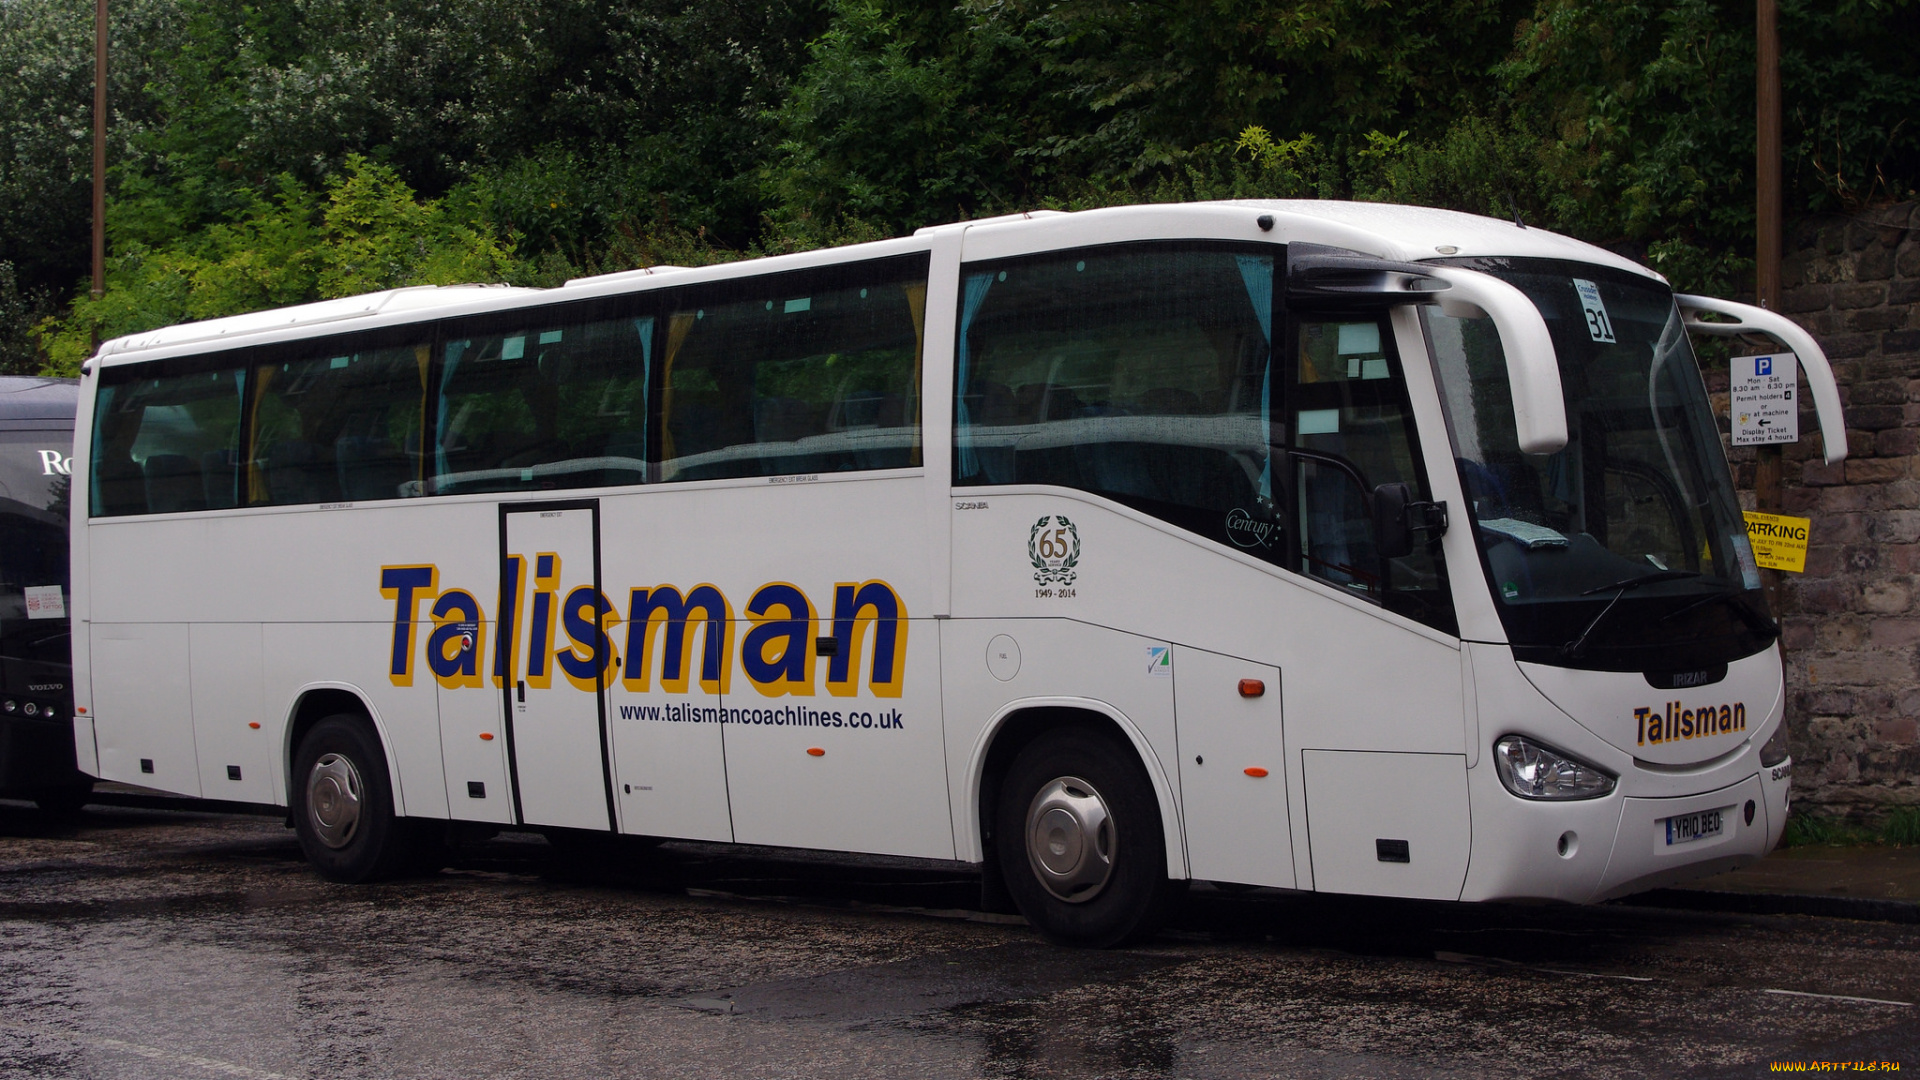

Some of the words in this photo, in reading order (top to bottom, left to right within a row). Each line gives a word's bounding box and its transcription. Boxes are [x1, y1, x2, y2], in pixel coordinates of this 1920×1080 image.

[1585, 308, 1614, 339] 31
[1742, 428, 1765, 436] Display
[955, 501, 989, 510] SCANIA
[1228, 515, 1274, 541] Century
[1039, 528, 1068, 559] 65
[1035, 589, 1053, 598] 1949
[1058, 589, 1076, 598] 2014
[379, 551, 909, 699] Talisman
[28, 683, 64, 691] VOLVO
[1673, 671, 1708, 687] IRIZAR
[619, 702, 904, 730] www.talismancoachlines.co.uk
[1633, 700, 1746, 746] Talisman
